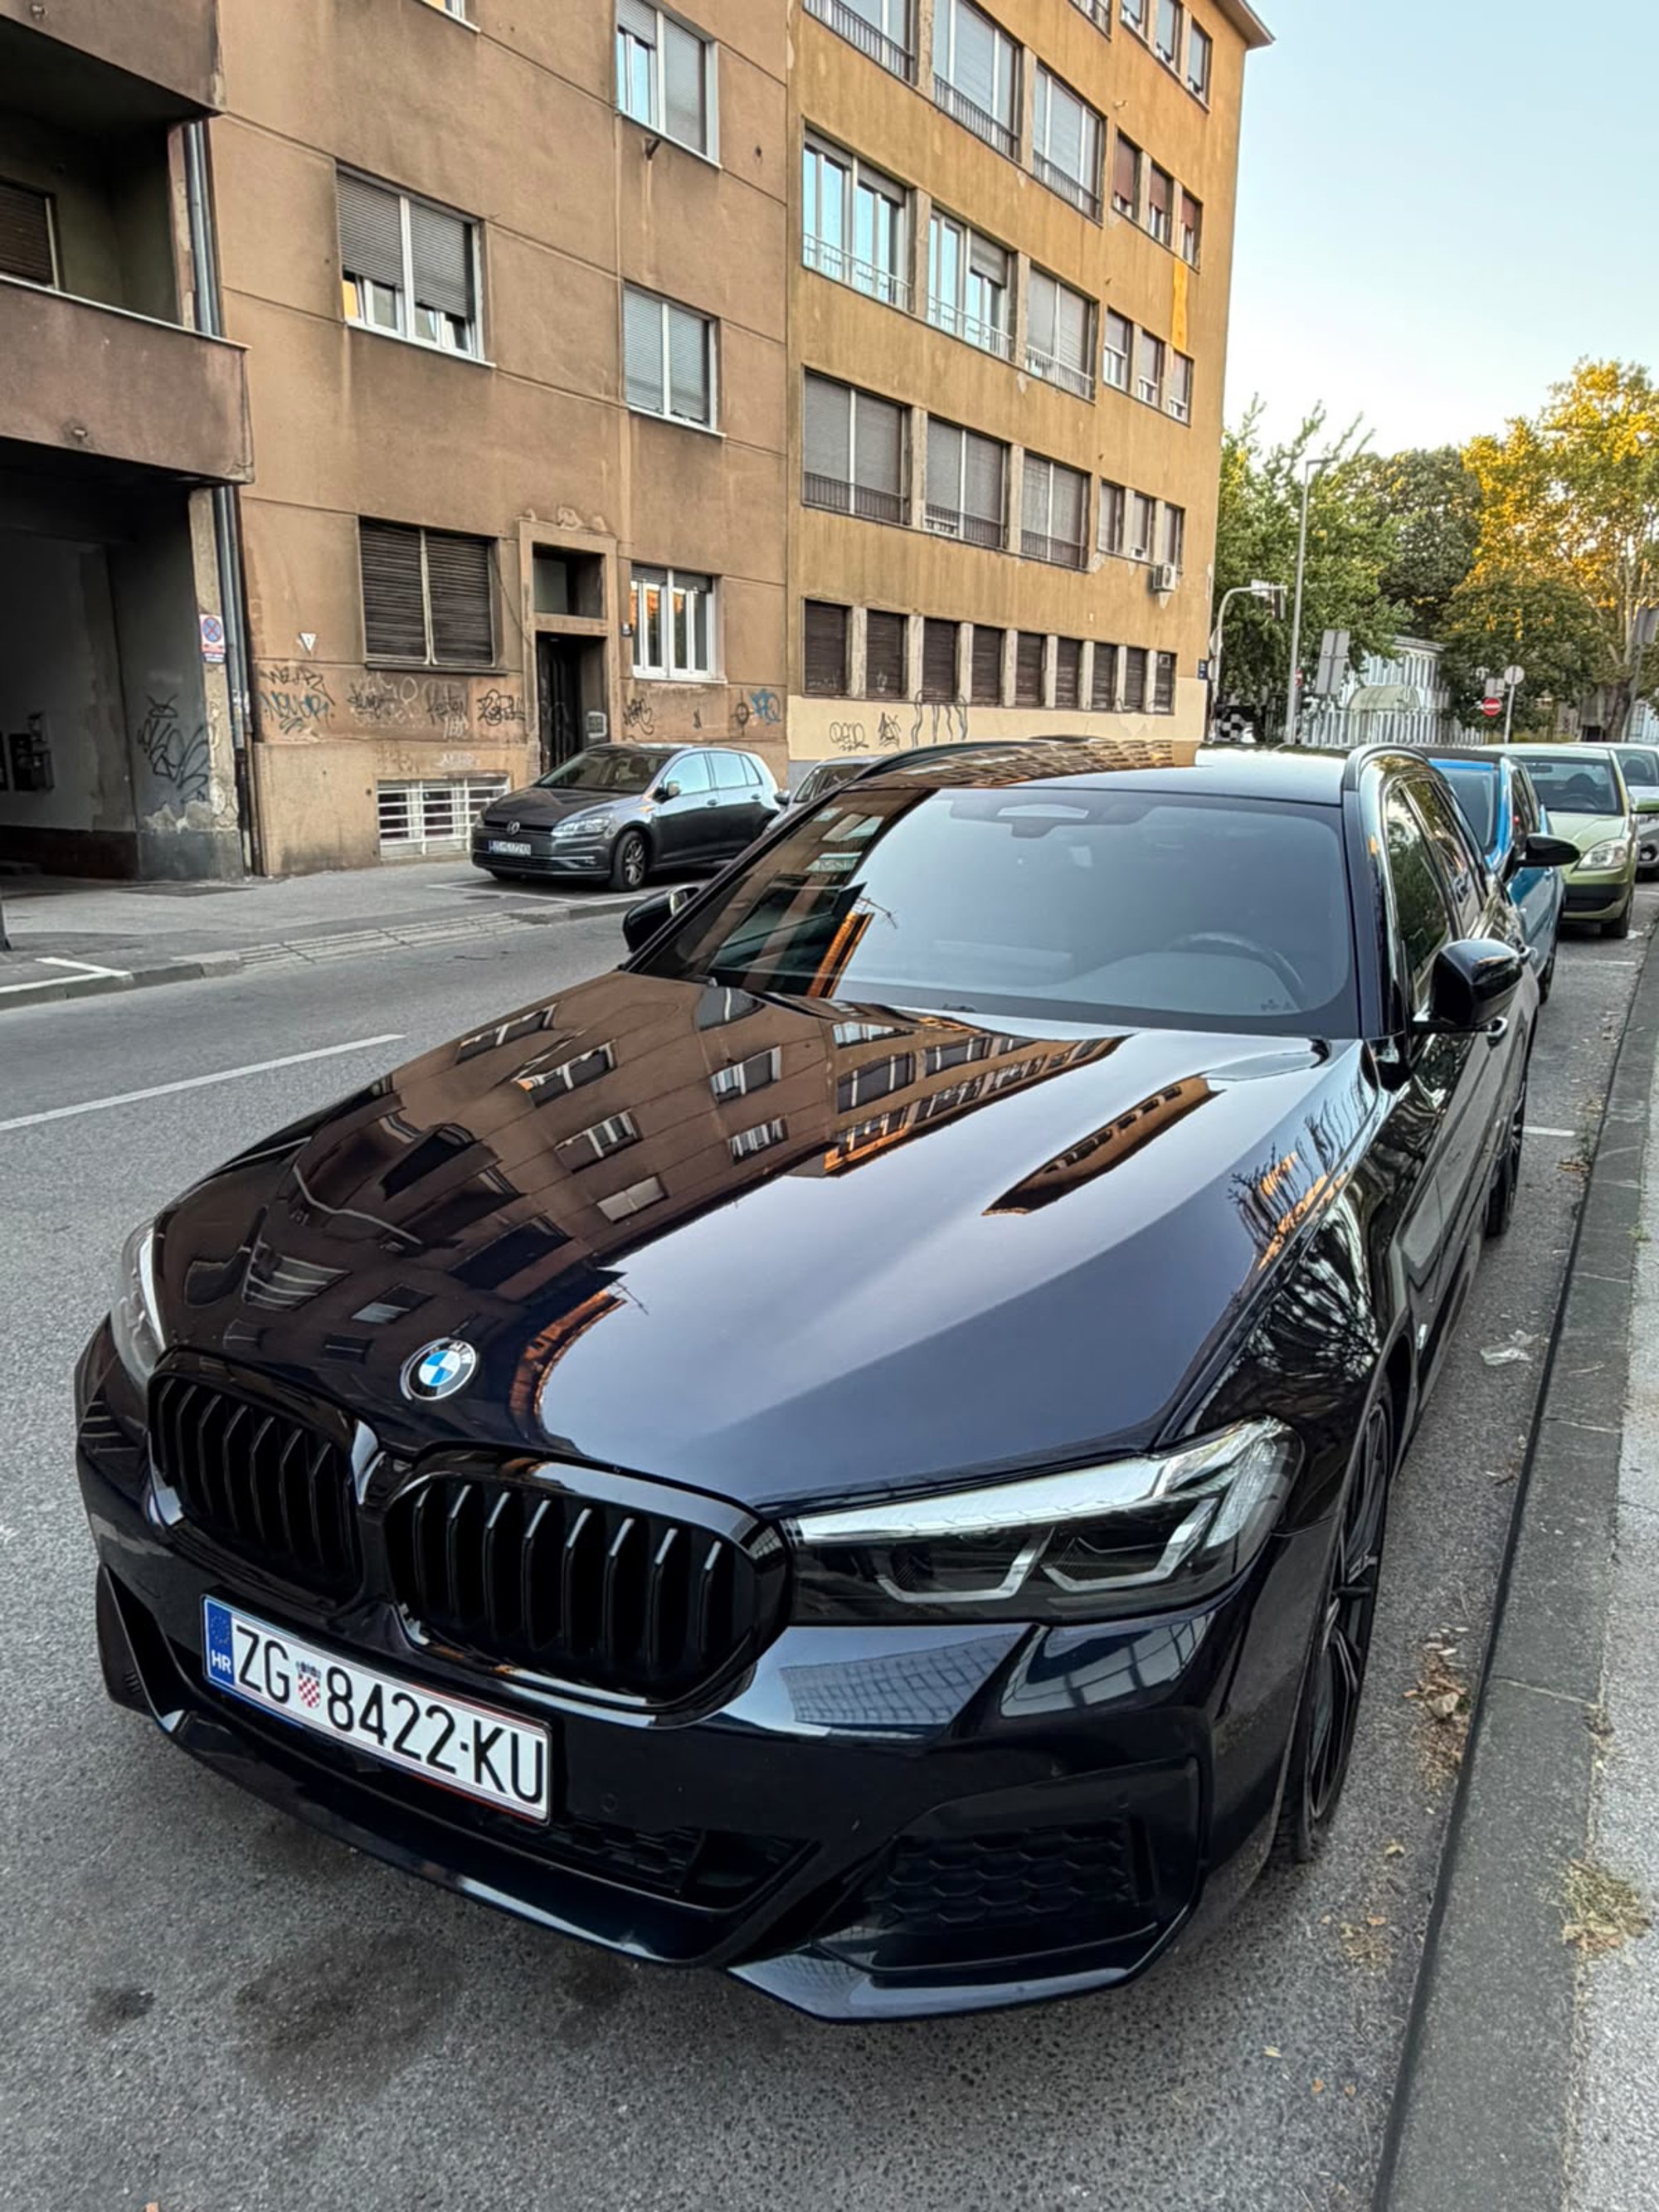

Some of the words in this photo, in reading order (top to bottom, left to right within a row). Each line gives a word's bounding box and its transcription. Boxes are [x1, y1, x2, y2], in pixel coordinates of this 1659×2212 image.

[211, 1649, 232, 1674] HR
[236, 1625, 290, 1704] ZG
[327, 1666, 544, 1805] 8422-KU
